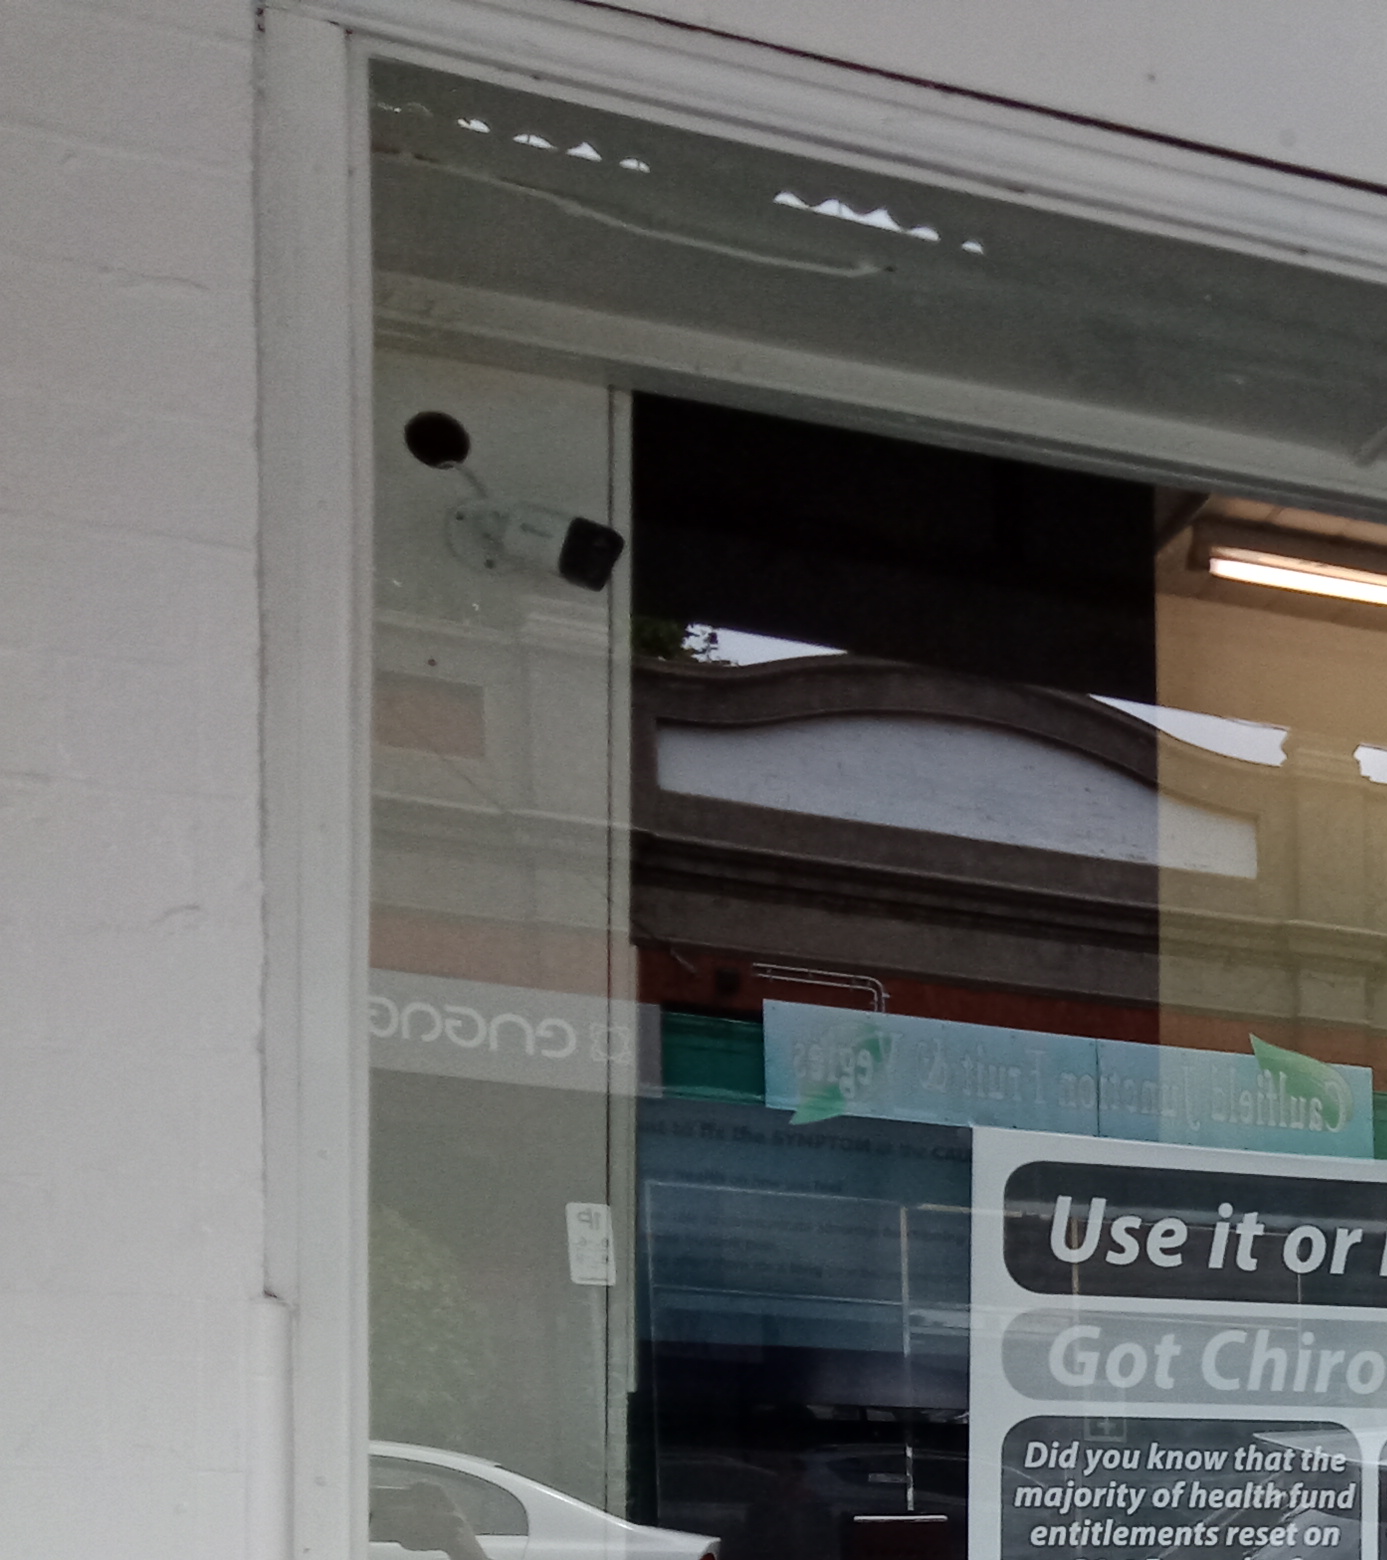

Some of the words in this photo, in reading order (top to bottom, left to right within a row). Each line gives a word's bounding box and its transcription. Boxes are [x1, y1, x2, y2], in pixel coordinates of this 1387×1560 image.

[1048, 1195, 1189, 1267] Use
[1208, 1202, 1264, 1270] it
[1282, 1224, 1365, 1275] or
[1048, 1325, 1179, 1389] Got
[1200, 1329, 1386, 1394] Chiro
[1024, 1441, 1078, 1470] Did
[1082, 1447, 1140, 1476] you
[1146, 1446, 1228, 1474] know
[1234, 1446, 1295, 1472] that
[1301, 1446, 1346, 1474] the
[1014, 1481, 1145, 1514] majority
[1152, 1481, 1186, 1509] of
[1189, 1482, 1282, 1511] health
[1288, 1482, 1354, 1511] fund
[1029, 1519, 1217, 1547] entitlements
[1225, 1524, 1296, 1548] reset
[1303, 1525, 1340, 1548] on
